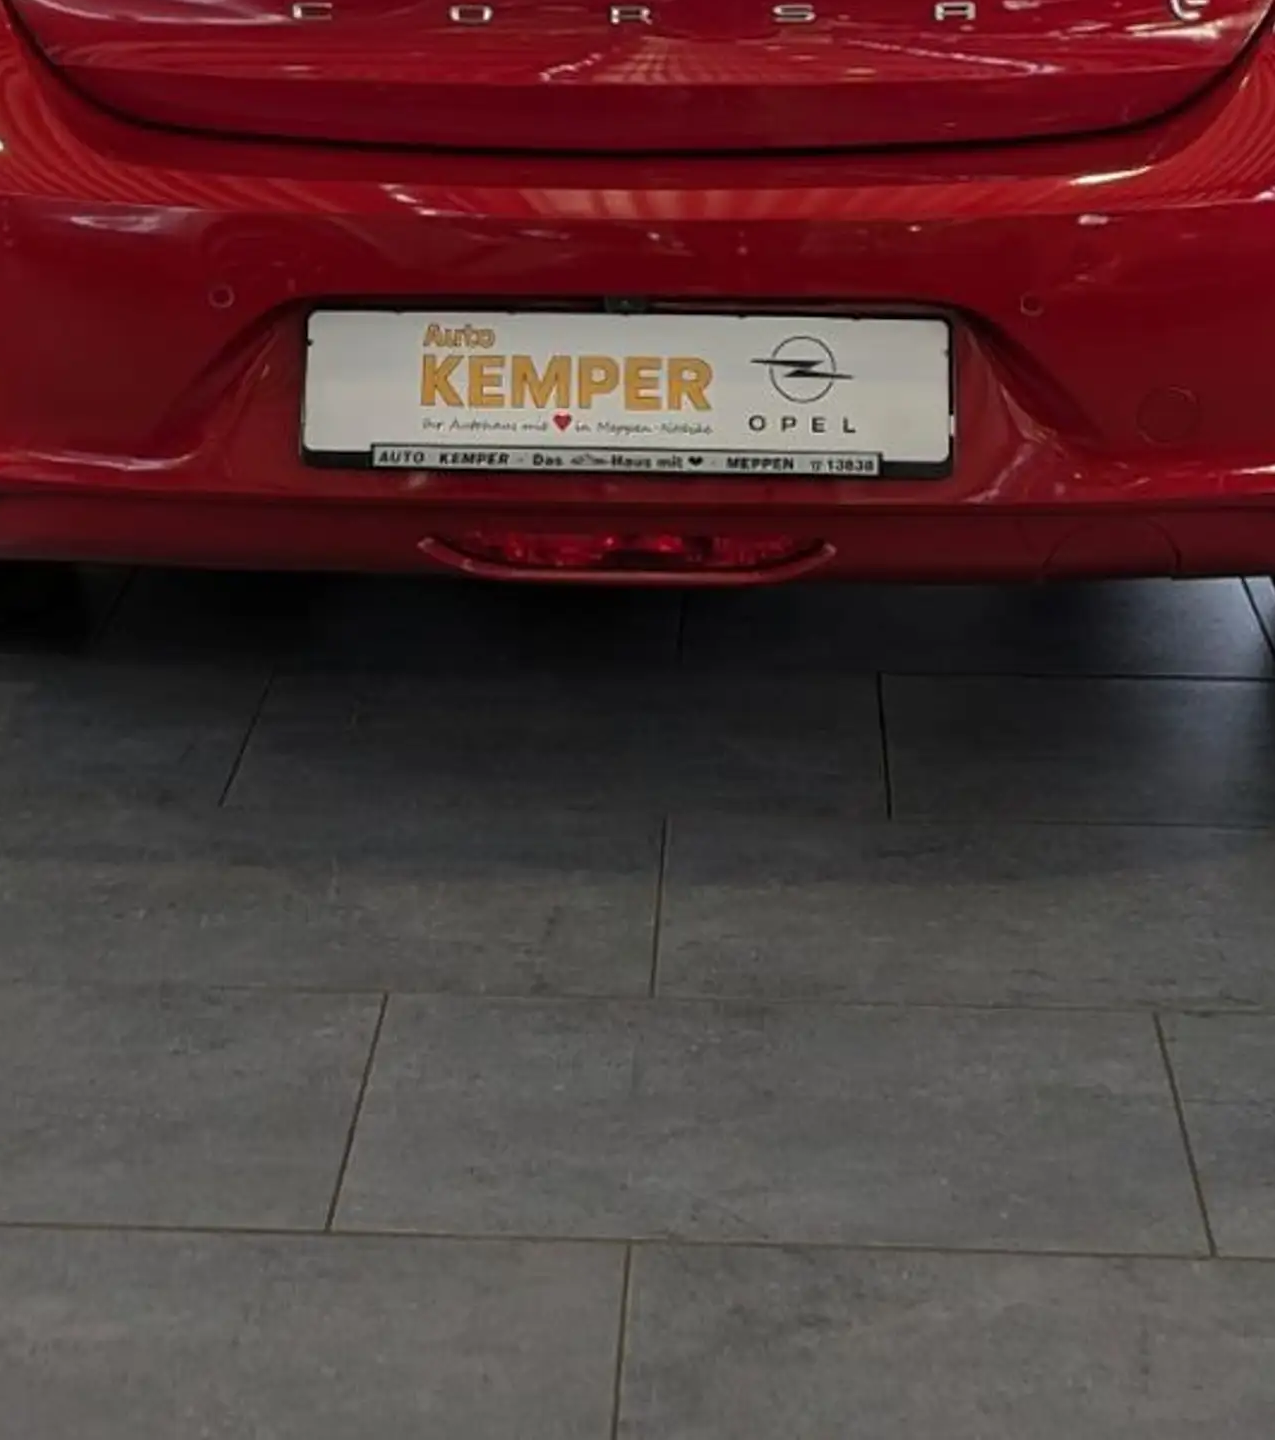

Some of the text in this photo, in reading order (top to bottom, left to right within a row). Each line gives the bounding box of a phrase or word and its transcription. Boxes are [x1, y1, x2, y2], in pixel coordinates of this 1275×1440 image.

[291, 1, 976, 24] CORSA
[423, 323, 496, 349] Auto
[420, 354, 714, 412] KEMPER
[449, 416, 517, 433] Autohaus
[522, 417, 548, 433] mit
[575, 418, 592, 434] in
[748, 414, 857, 434] OPEL
[379, 451, 425, 465] AUTO
[439, 452, 511, 466] KEMPER
[532, 453, 564, 467] Das
[656, 455, 684, 469] mit
[727, 456, 795, 471] MEPPEN
